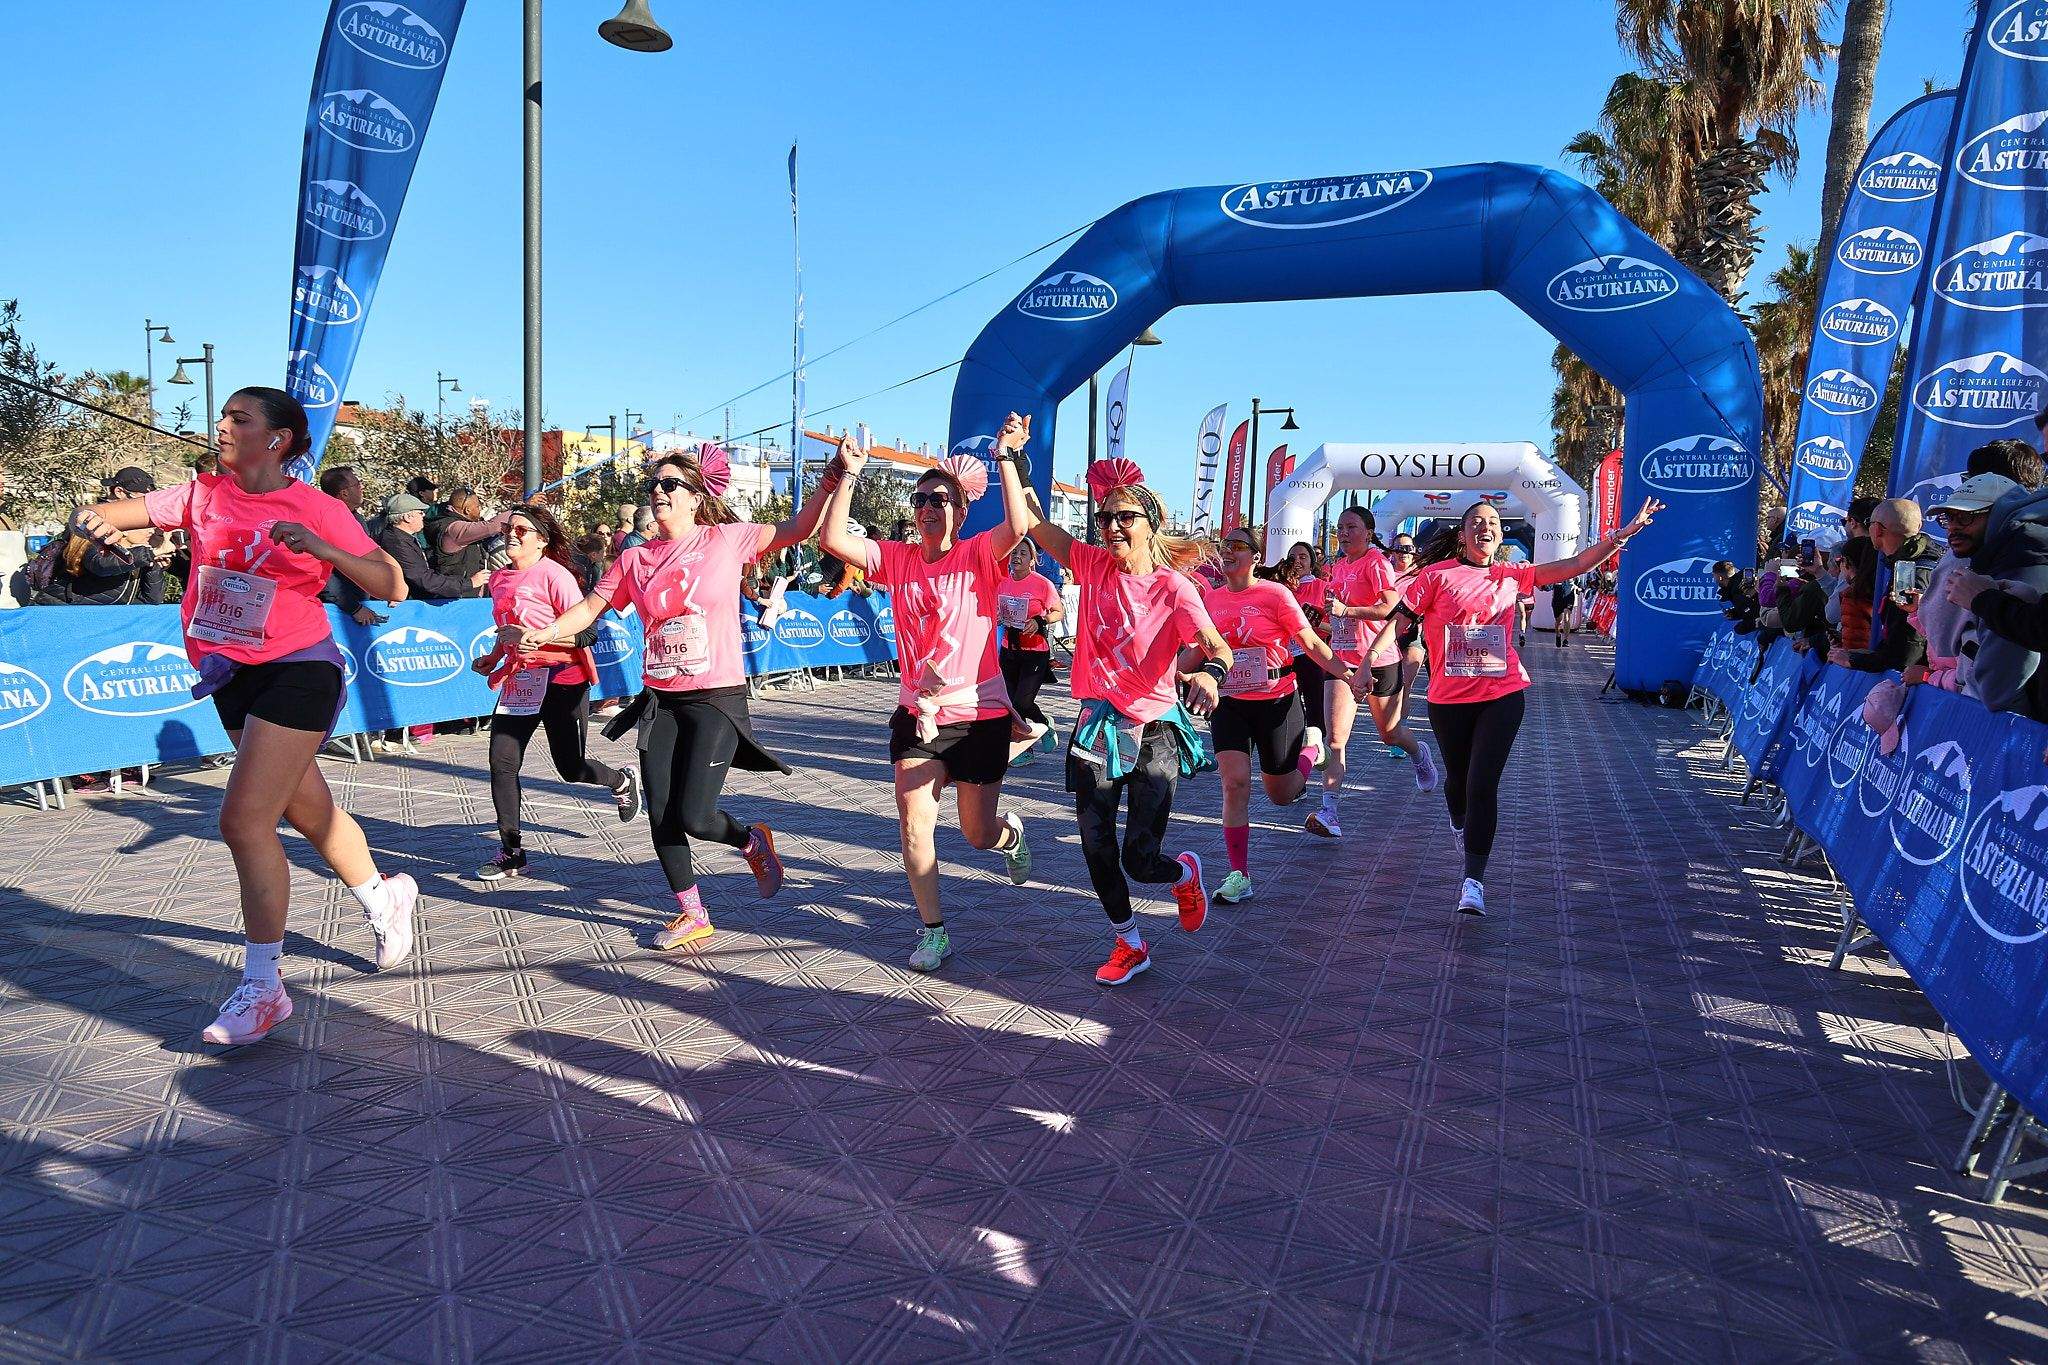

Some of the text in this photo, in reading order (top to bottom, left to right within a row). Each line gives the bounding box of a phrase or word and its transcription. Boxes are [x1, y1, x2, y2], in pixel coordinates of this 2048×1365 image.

[343, 11, 437, 64] ASTURIANA
[320, 100, 404, 148] ASTURIANA
[2000, 137, 2048, 149] CENTRA
[1861, 169, 1937, 191] ASTURIANA
[1234, 176, 1415, 212] ASTURIANA
[1842, 241, 1914, 265] ASTURIANA
[1575, 271, 1665, 284] CENTRAL LECHERA
[1943, 262, 2048, 292] ASTURIA
[1557, 278, 1671, 301] ASTURIANA
[1022, 292, 1109, 309] ASTURIANA
[1824, 311, 1889, 337] ASTURIANA
[1949, 378, 1998, 386] CENTRAL
[1811, 381, 1867, 408] ASTURIANA
[1923, 379, 2039, 412] ASTURIANA
[1228, 441, 1242, 508] Santander
[1360, 453, 1486, 479] OYSHO
[1646, 457, 1750, 479] ASTURIANA
[1288, 480, 1324, 490] OYSHO
[1521, 479, 1562, 490] OYSHO
[1605, 469, 1616, 526] Santander
[1270, 527, 1303, 537] OYSHO
[219, 603, 244, 618] 016
[196, 628, 216, 638] OYSHO
[779, 625, 823, 639] ASTURIANA
[832, 624, 869, 638] ASTURIANA
[386, 647, 419, 656] CENTRAL
[664, 643, 688, 655] 016
[1466, 647, 1489, 657] 016
[376, 650, 460, 674] ASTURIANA
[100, 667, 149, 678] CENTRAL
[1232, 669, 1251, 679] 016
[516, 688, 533, 697] 016
[1895, 768, 1957, 849] ASTURIANA
